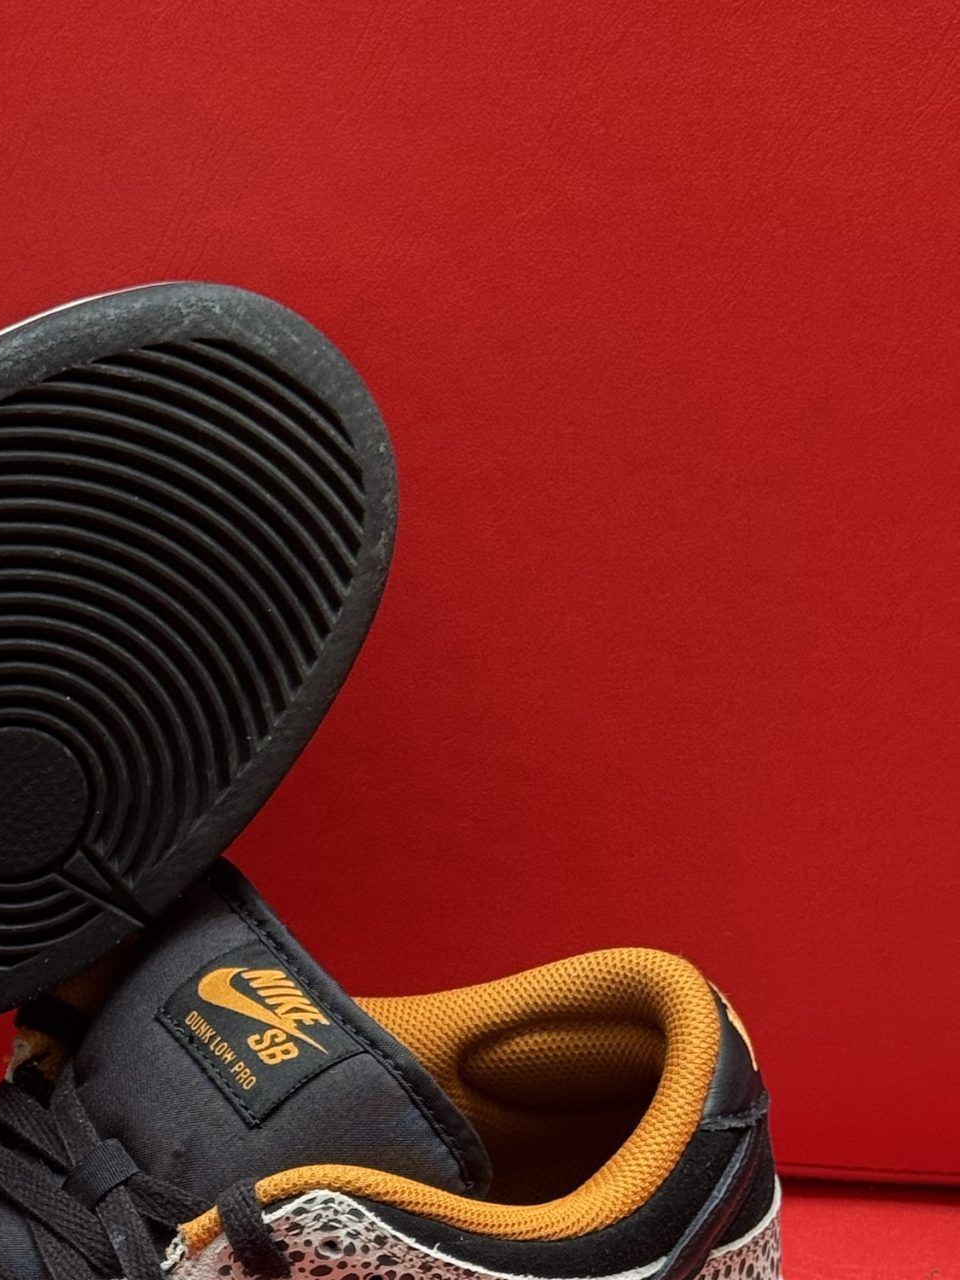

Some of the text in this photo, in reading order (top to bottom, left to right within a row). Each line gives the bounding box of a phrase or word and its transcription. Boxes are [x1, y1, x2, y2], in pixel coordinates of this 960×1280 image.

[240, 969, 330, 1027] NIKE
[185, 1010, 258, 1091] DUNK LOW PRO
[246, 1028, 300, 1066] SB
